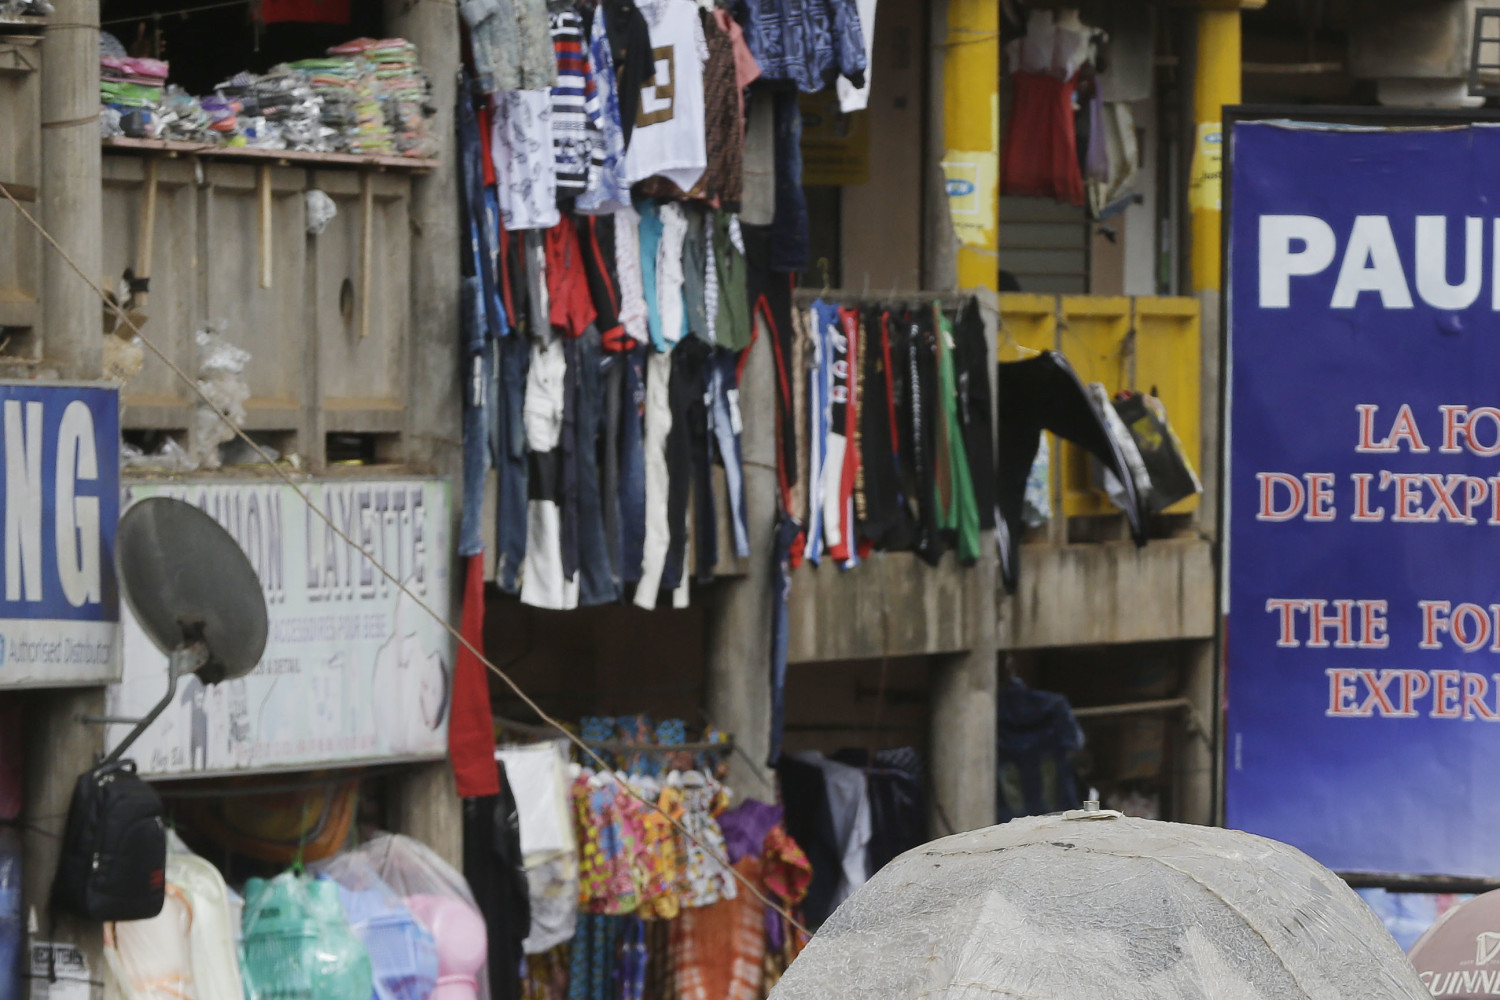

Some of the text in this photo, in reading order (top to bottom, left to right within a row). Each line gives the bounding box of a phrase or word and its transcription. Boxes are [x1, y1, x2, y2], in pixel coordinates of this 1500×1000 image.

[1355, 404, 1427, 454] LA
[1257, 473, 1336, 521] DE
[307, 486, 427, 602] LAYETTE
[1266, 598, 1389, 648] THE
